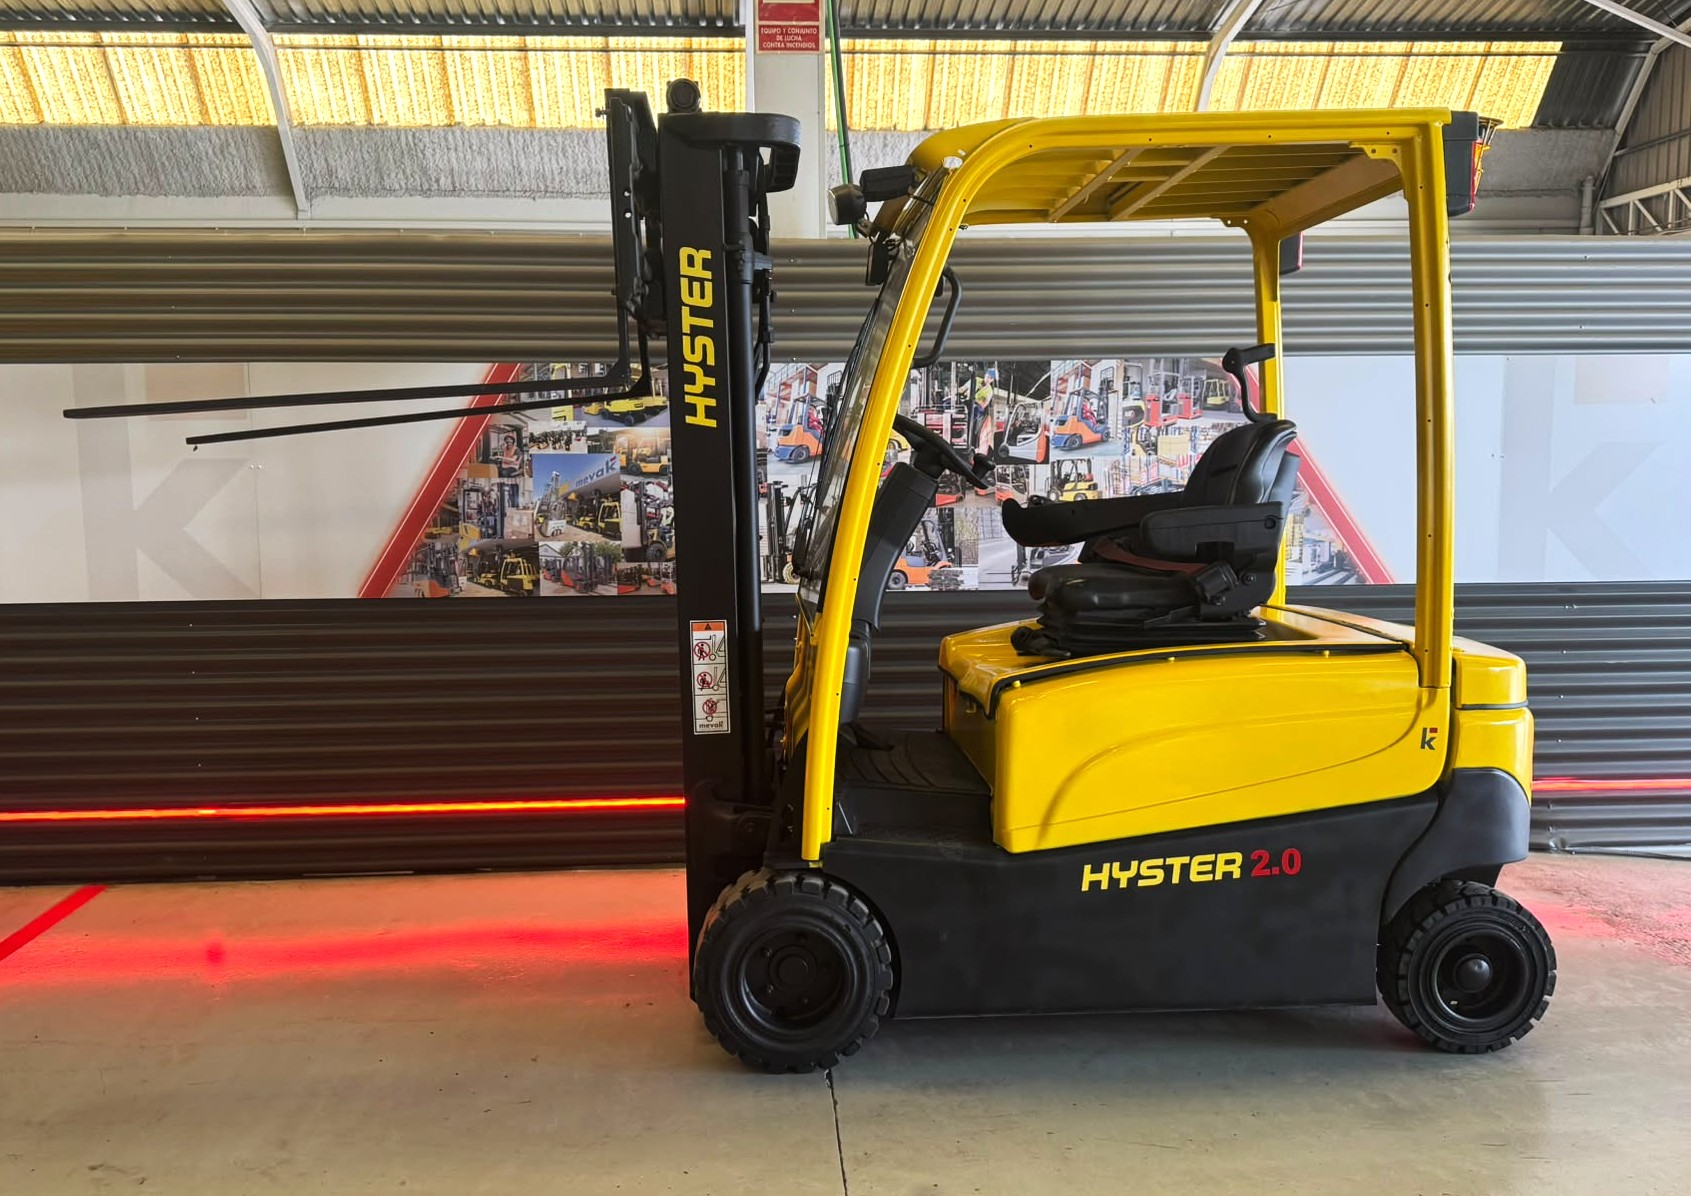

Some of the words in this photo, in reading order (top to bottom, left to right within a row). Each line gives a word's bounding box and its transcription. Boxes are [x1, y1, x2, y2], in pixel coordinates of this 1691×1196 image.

[679, 246, 717, 428] HYSTER
[575, 456, 617, 487] mevak
[699, 720, 724, 729] mevak
[1081, 851, 1243, 892] HYSTER
[1250, 847, 1302, 877] 2.0
